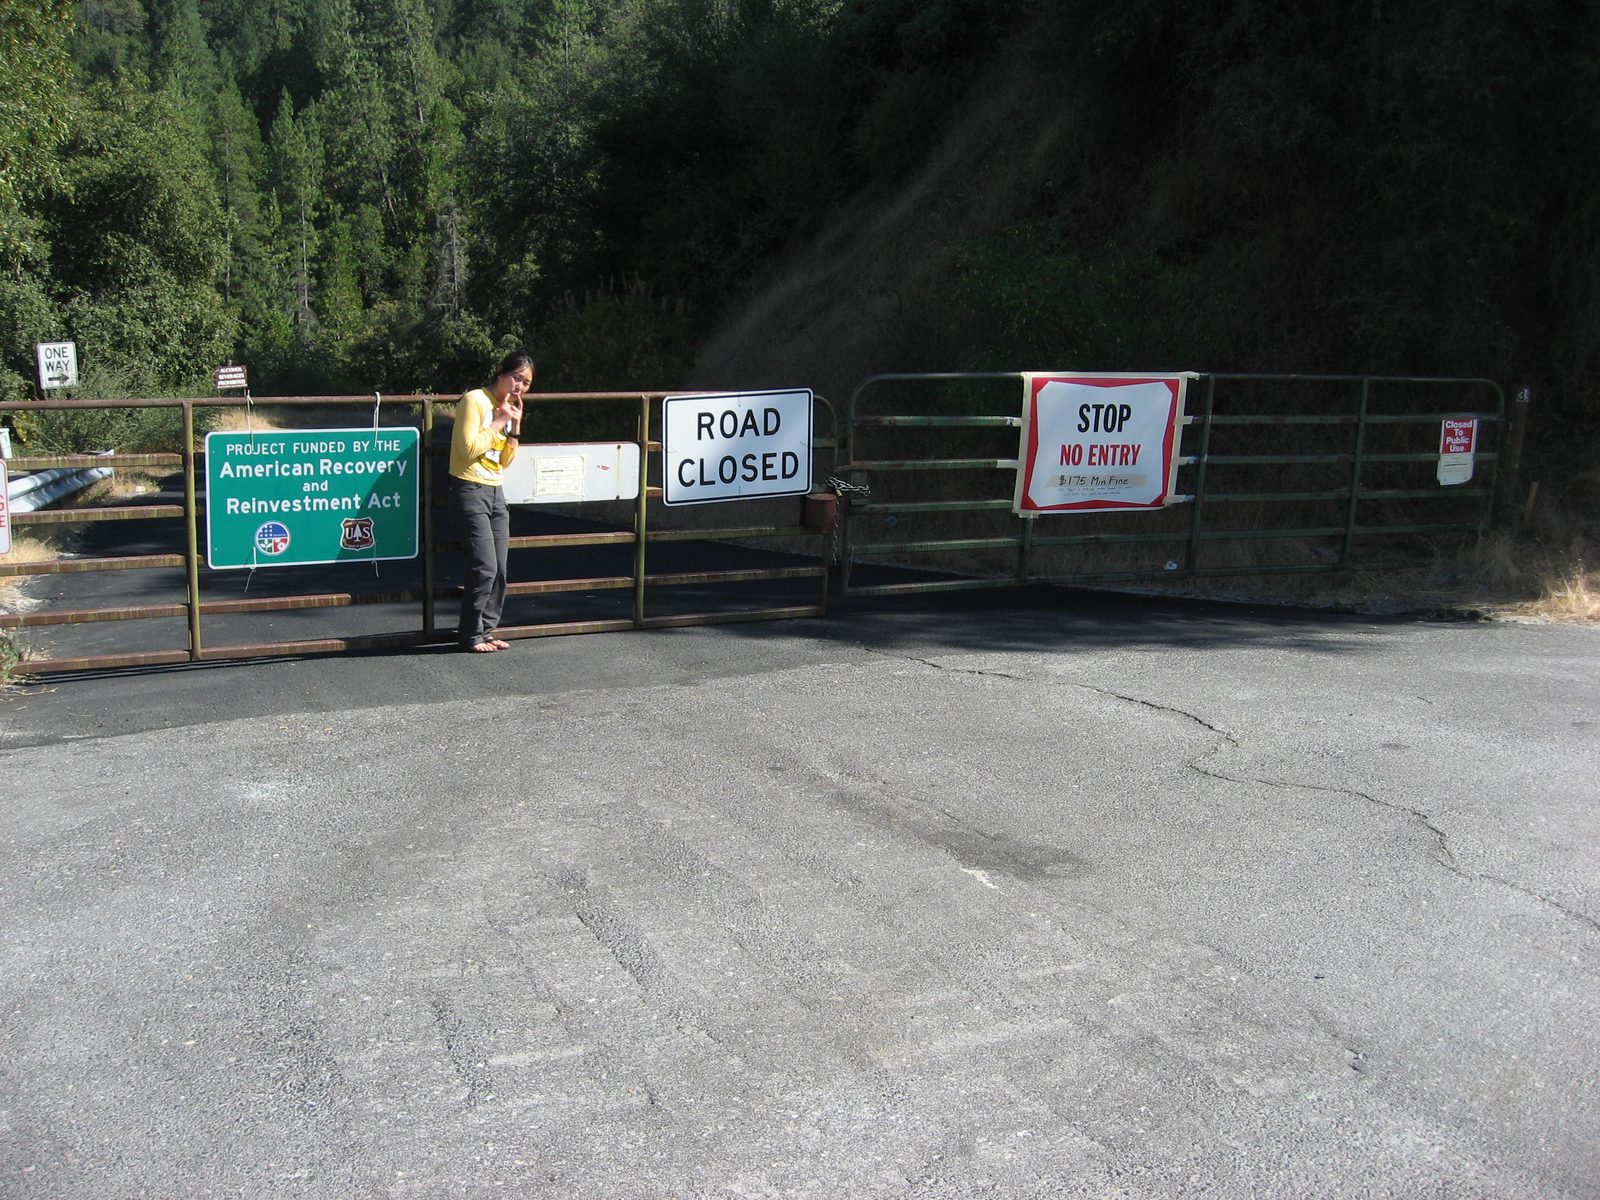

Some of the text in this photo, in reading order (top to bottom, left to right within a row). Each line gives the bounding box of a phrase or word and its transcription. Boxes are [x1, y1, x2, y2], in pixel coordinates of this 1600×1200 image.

[45, 347, 69, 359] ONE
[45, 360, 70, 372] WAY
[697, 408, 781, 440] ROAD
[1077, 404, 1131, 432] STOP
[1445, 420, 1473, 429] Closed
[226, 440, 400, 455] PROJECT FUNDED BY THE
[1446, 437, 1470, 445] Public
[1060, 443, 1141, 466] NO ENTRY
[1449, 444, 1464, 452] Use
[220, 458, 407, 478] American Recovery
[678, 451, 799, 487] CLOSED
[302, 480, 328, 492] and
[1059, 475, 1128, 486] $175 Min Fine
[226, 492, 400, 514] Reinvestment Act
